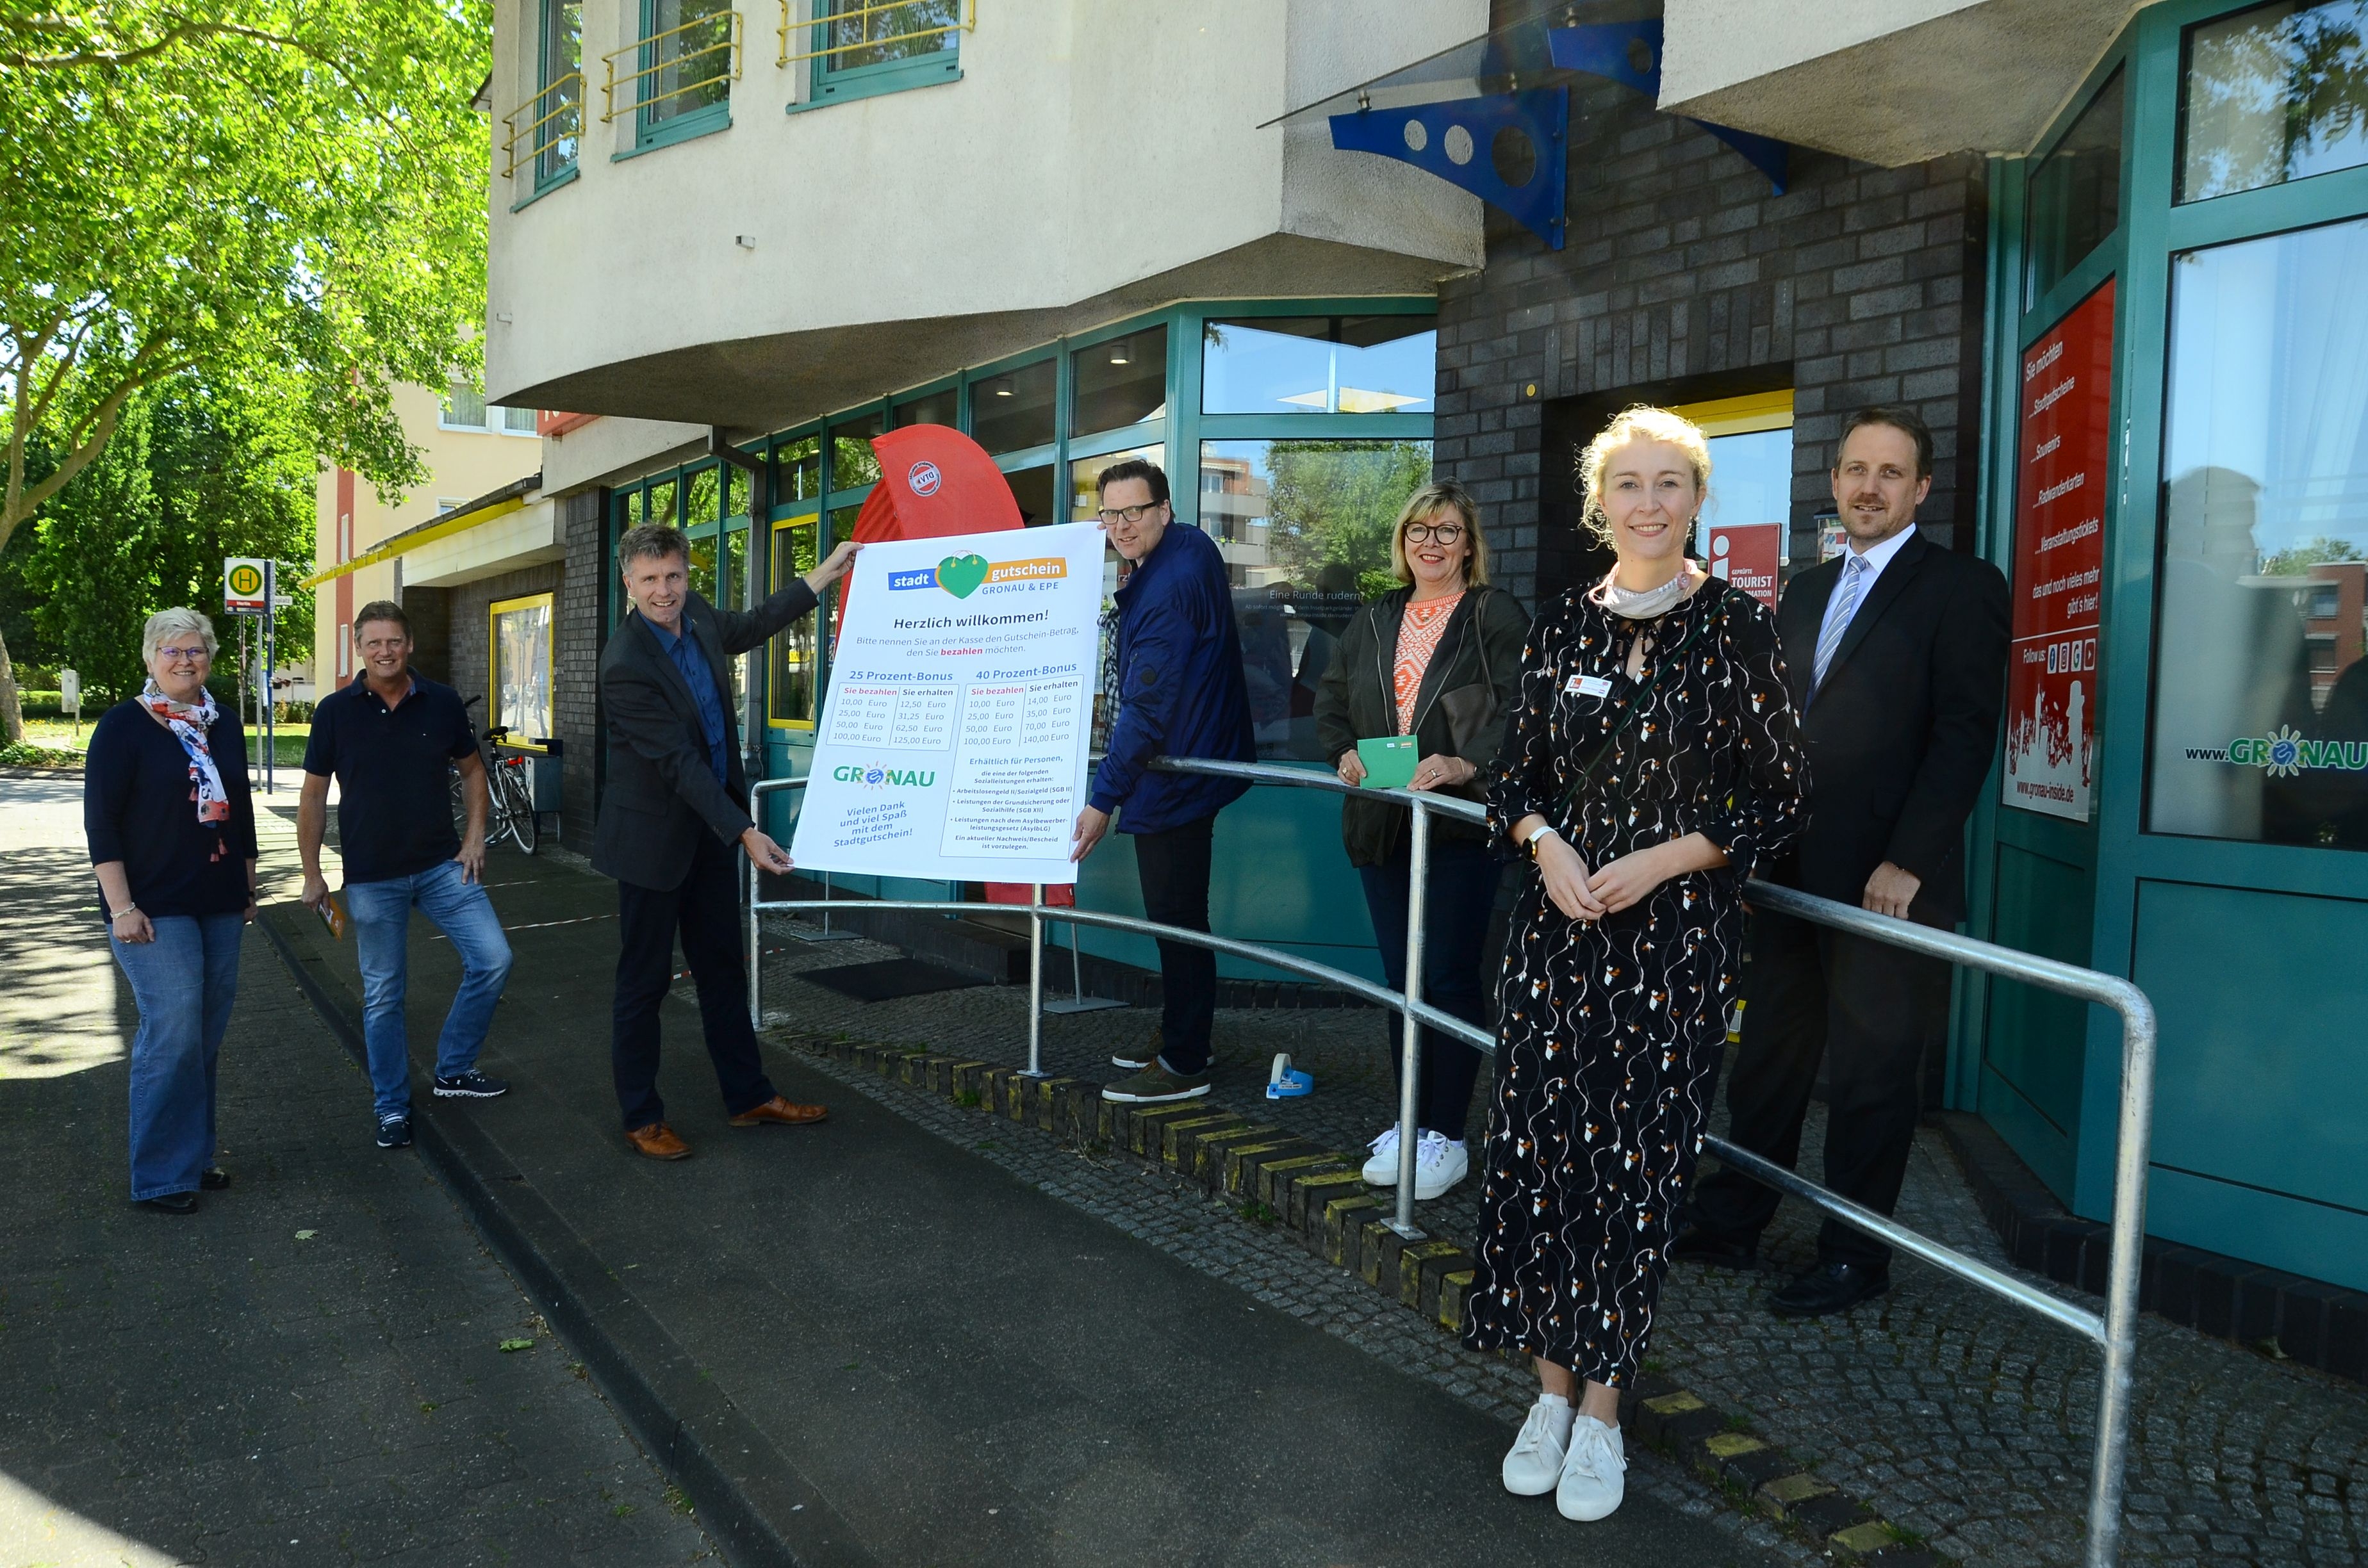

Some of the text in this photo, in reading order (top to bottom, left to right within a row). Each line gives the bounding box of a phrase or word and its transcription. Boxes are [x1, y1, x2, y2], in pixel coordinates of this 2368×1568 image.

[2026, 341, 2063, 382] Sie möchten
[239, 571, 252, 589] H
[894, 562, 1061, 587] stadt gutschein
[1731, 576, 1773, 588] TOURIST
[2032, 566, 2100, 600] das und noch vieles mehr
[982, 582, 1059, 595] GRONAU & EPE
[1270, 590, 1365, 601] Eine Runde rudern?
[2084, 592, 2098, 611] hier!
[894, 609, 1049, 629] Herzlich willkommen!
[942, 637, 957, 645] der
[958, 636, 983, 644] Kasse
[985, 635, 1002, 643] den
[1004, 626, 1079, 641] Gutschein-Betrag,
[985, 645, 1026, 654] möchten.
[2023, 648, 2039, 664] Follow
[850, 671, 953, 681] 25 Prozent-Bonus
[976, 663, 1077, 680] 40 Prozent-Bonus
[1044, 680, 1078, 690] erhalten
[986, 687, 1024, 695] bezahlen
[1028, 694, 1072, 705] 14,00 Euro
[838, 710, 860, 718] 25,00
[967, 713, 989, 721] 25,00
[1026, 706, 1071, 718] 35,00 Euro
[835, 721, 884, 731] 50,00 Euro
[896, 724, 918, 733] 62,50
[966, 725, 988, 733] 50,00
[1025, 720, 1070, 731] 70,00 Euro
[833, 733, 860, 741] 100,00
[893, 737, 920, 745] 125,00
[1023, 733, 1069, 744] 140,00 Euro
[1024, 755, 1063, 764] Personen,
[833, 765, 935, 788] GRONAU
[847, 801, 905, 817] Vielen Dank
[840, 810, 907, 827] und viel Spaß
[851, 824, 892, 835] mit dem
[834, 828, 912, 847] Stadtgutschein!
